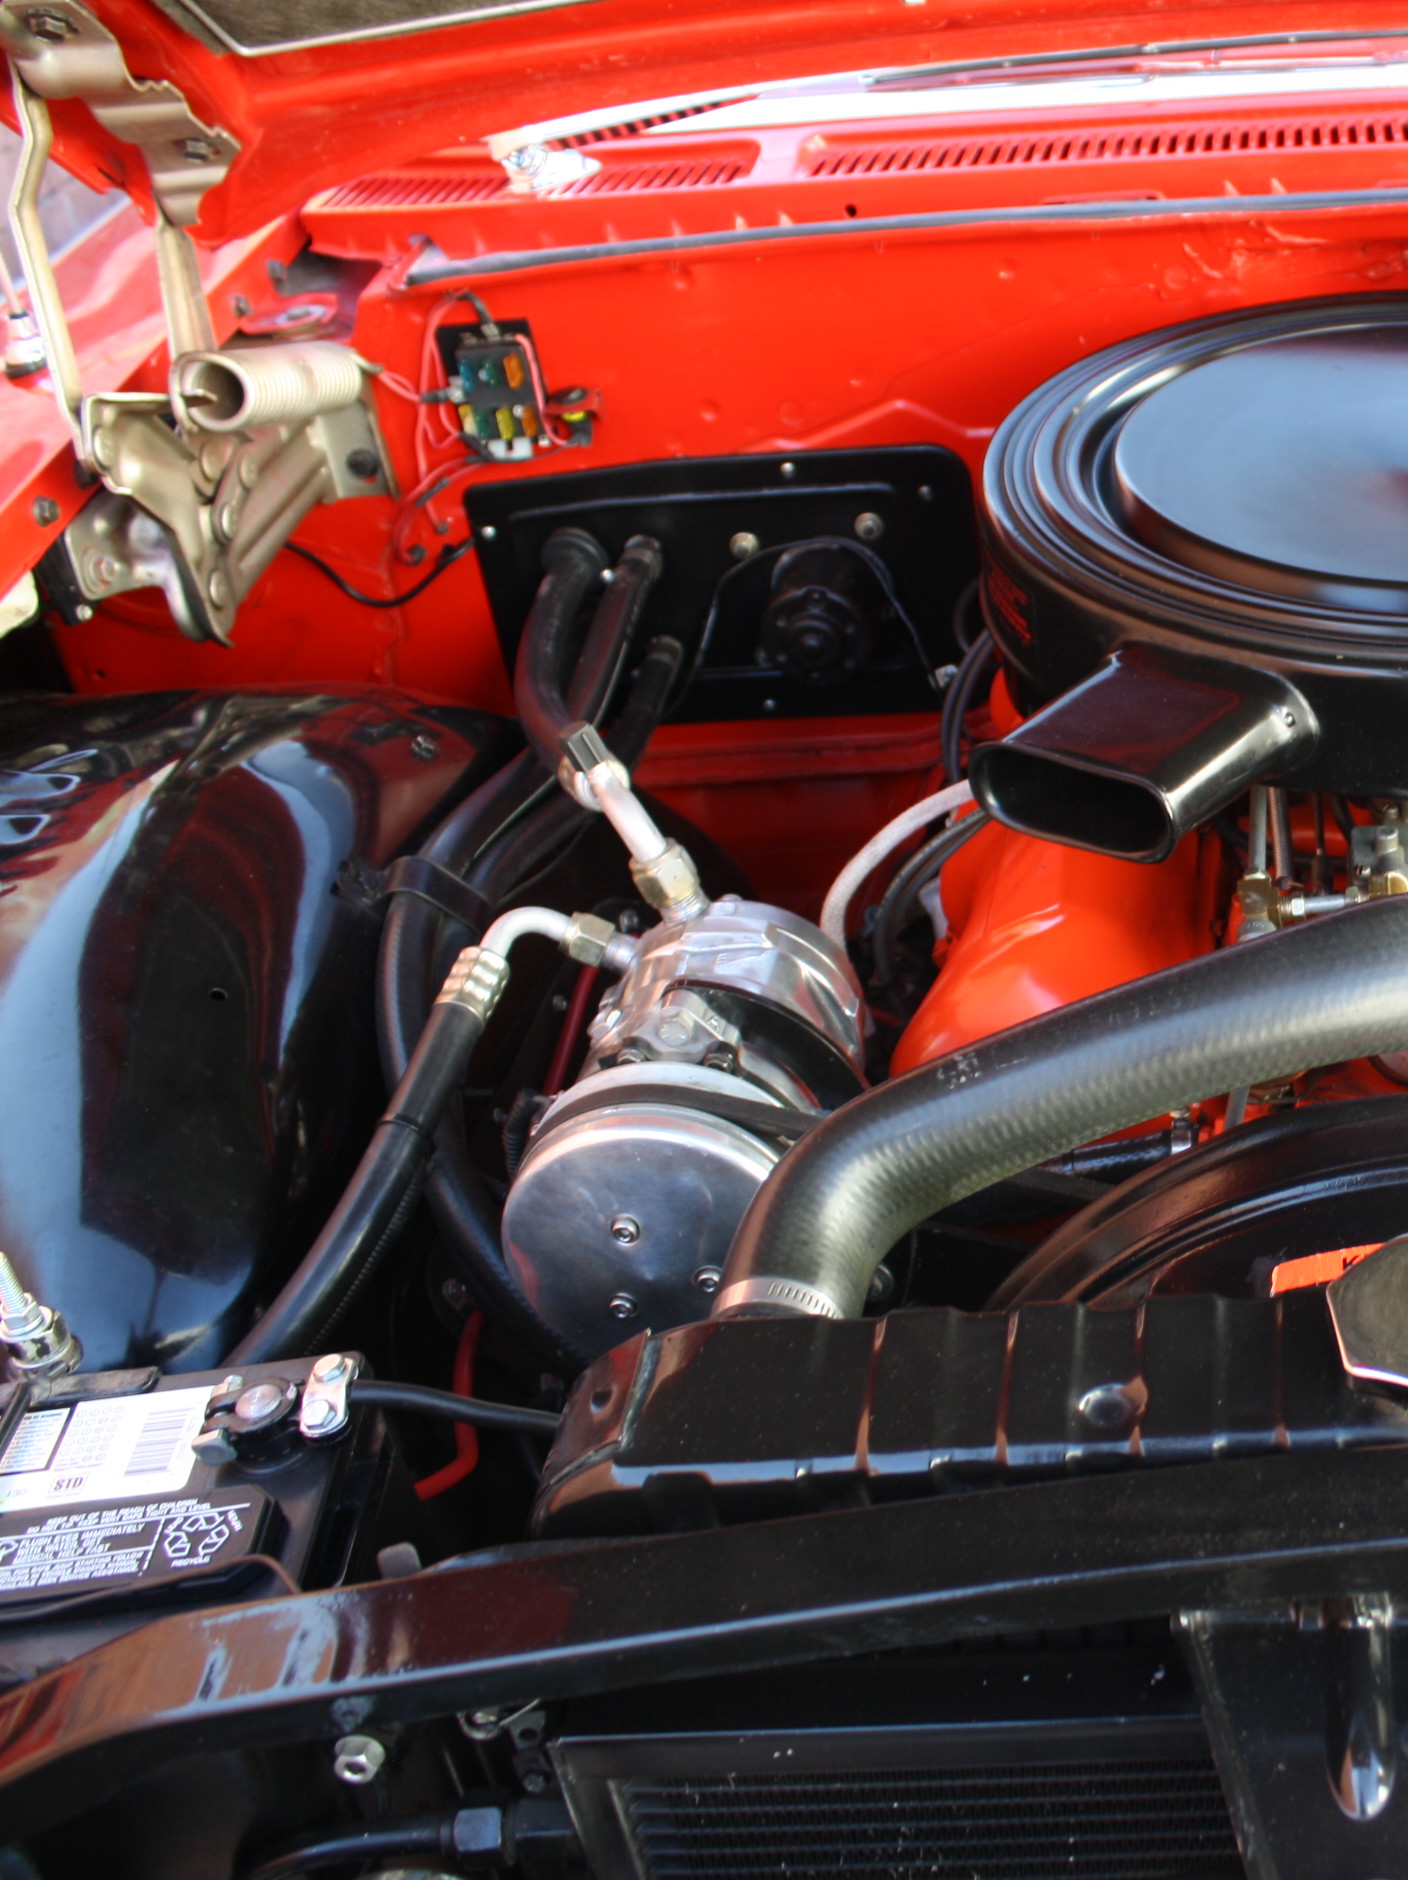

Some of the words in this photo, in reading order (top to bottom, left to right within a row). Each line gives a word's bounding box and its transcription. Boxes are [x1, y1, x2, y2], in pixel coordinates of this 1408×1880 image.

[19, 1536, 53, 1547] FLUSH
[53, 1532, 80, 1542] EYES
[80, 1522, 145, 1538] IMMEDIATELY
[12, 1551, 55, 1564] MEDICAL
[57, 1547, 84, 1557] HELP
[85, 1543, 111, 1553] FAST
[16, 1545, 43, 1555] WITH
